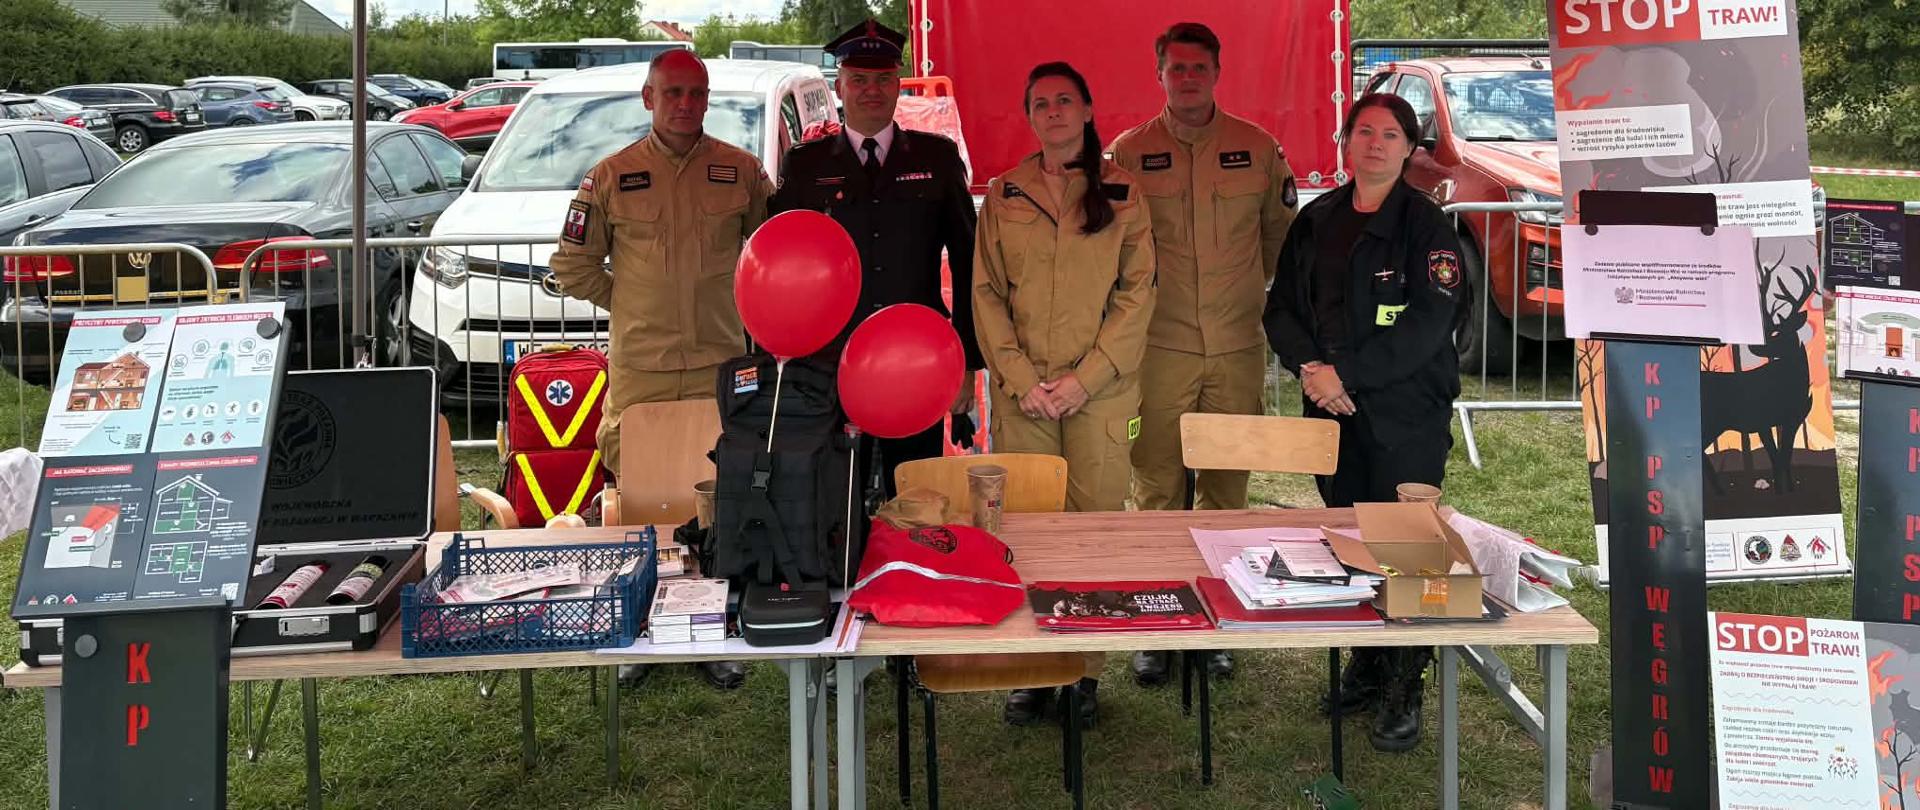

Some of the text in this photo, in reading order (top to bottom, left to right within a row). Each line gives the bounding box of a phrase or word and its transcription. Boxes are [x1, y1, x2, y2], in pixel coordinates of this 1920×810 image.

[1565, 0, 1690, 34] STOP
[1708, 6, 1777, 26] TRAW!
[1647, 454, 1665, 551] PSP
[1718, 622, 1805, 653] STOP
[1810, 627, 1860, 641] POŻAROM
[1811, 642, 1860, 658] TRAW!
[127, 641, 152, 747] KP
